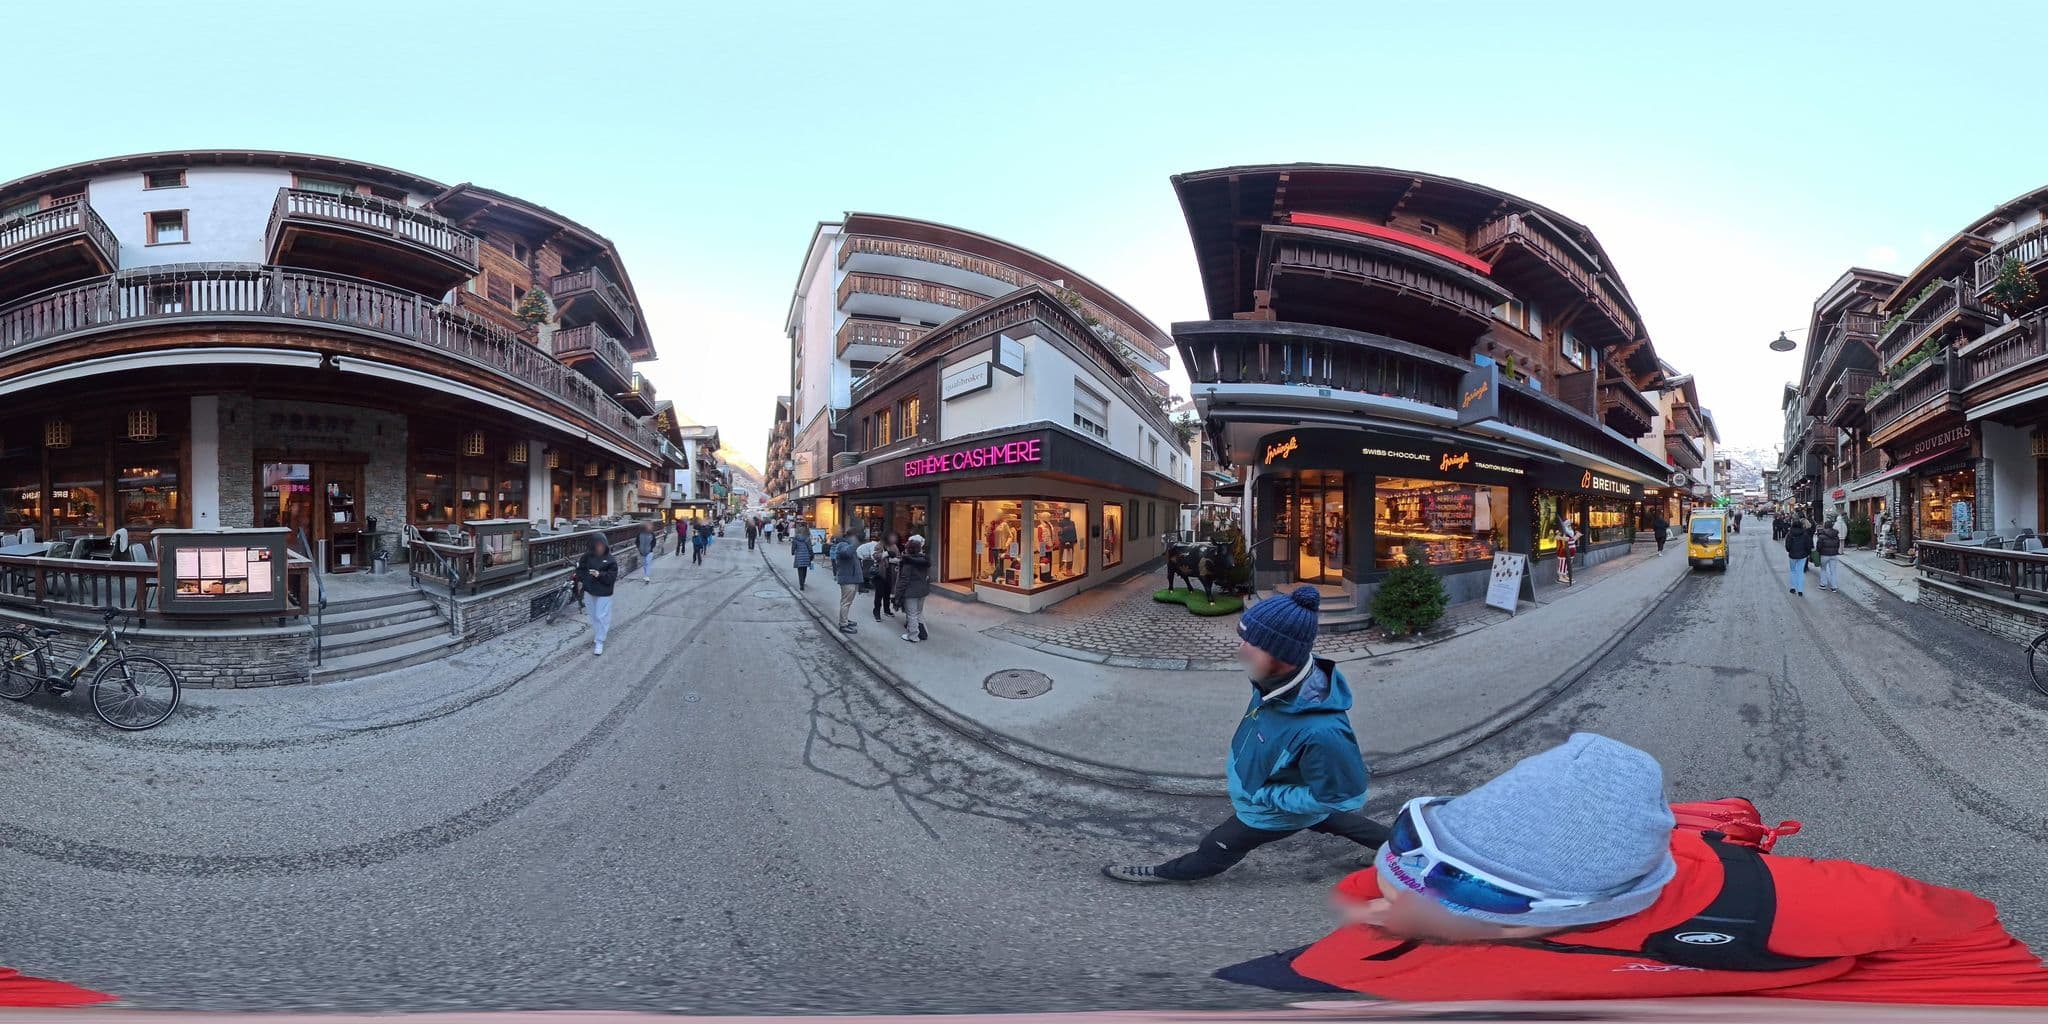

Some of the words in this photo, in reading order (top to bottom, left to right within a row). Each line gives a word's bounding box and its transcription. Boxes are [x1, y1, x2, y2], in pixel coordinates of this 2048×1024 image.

[1914, 424, 1971, 455] SOUVENIRS
[952, 439, 1041, 470] CASHMERE
[1362, 448, 1387, 457] SWISS
[1387, 450, 1432, 461] CHOCOLATE
[1592, 476, 1631, 495] BREITLING
